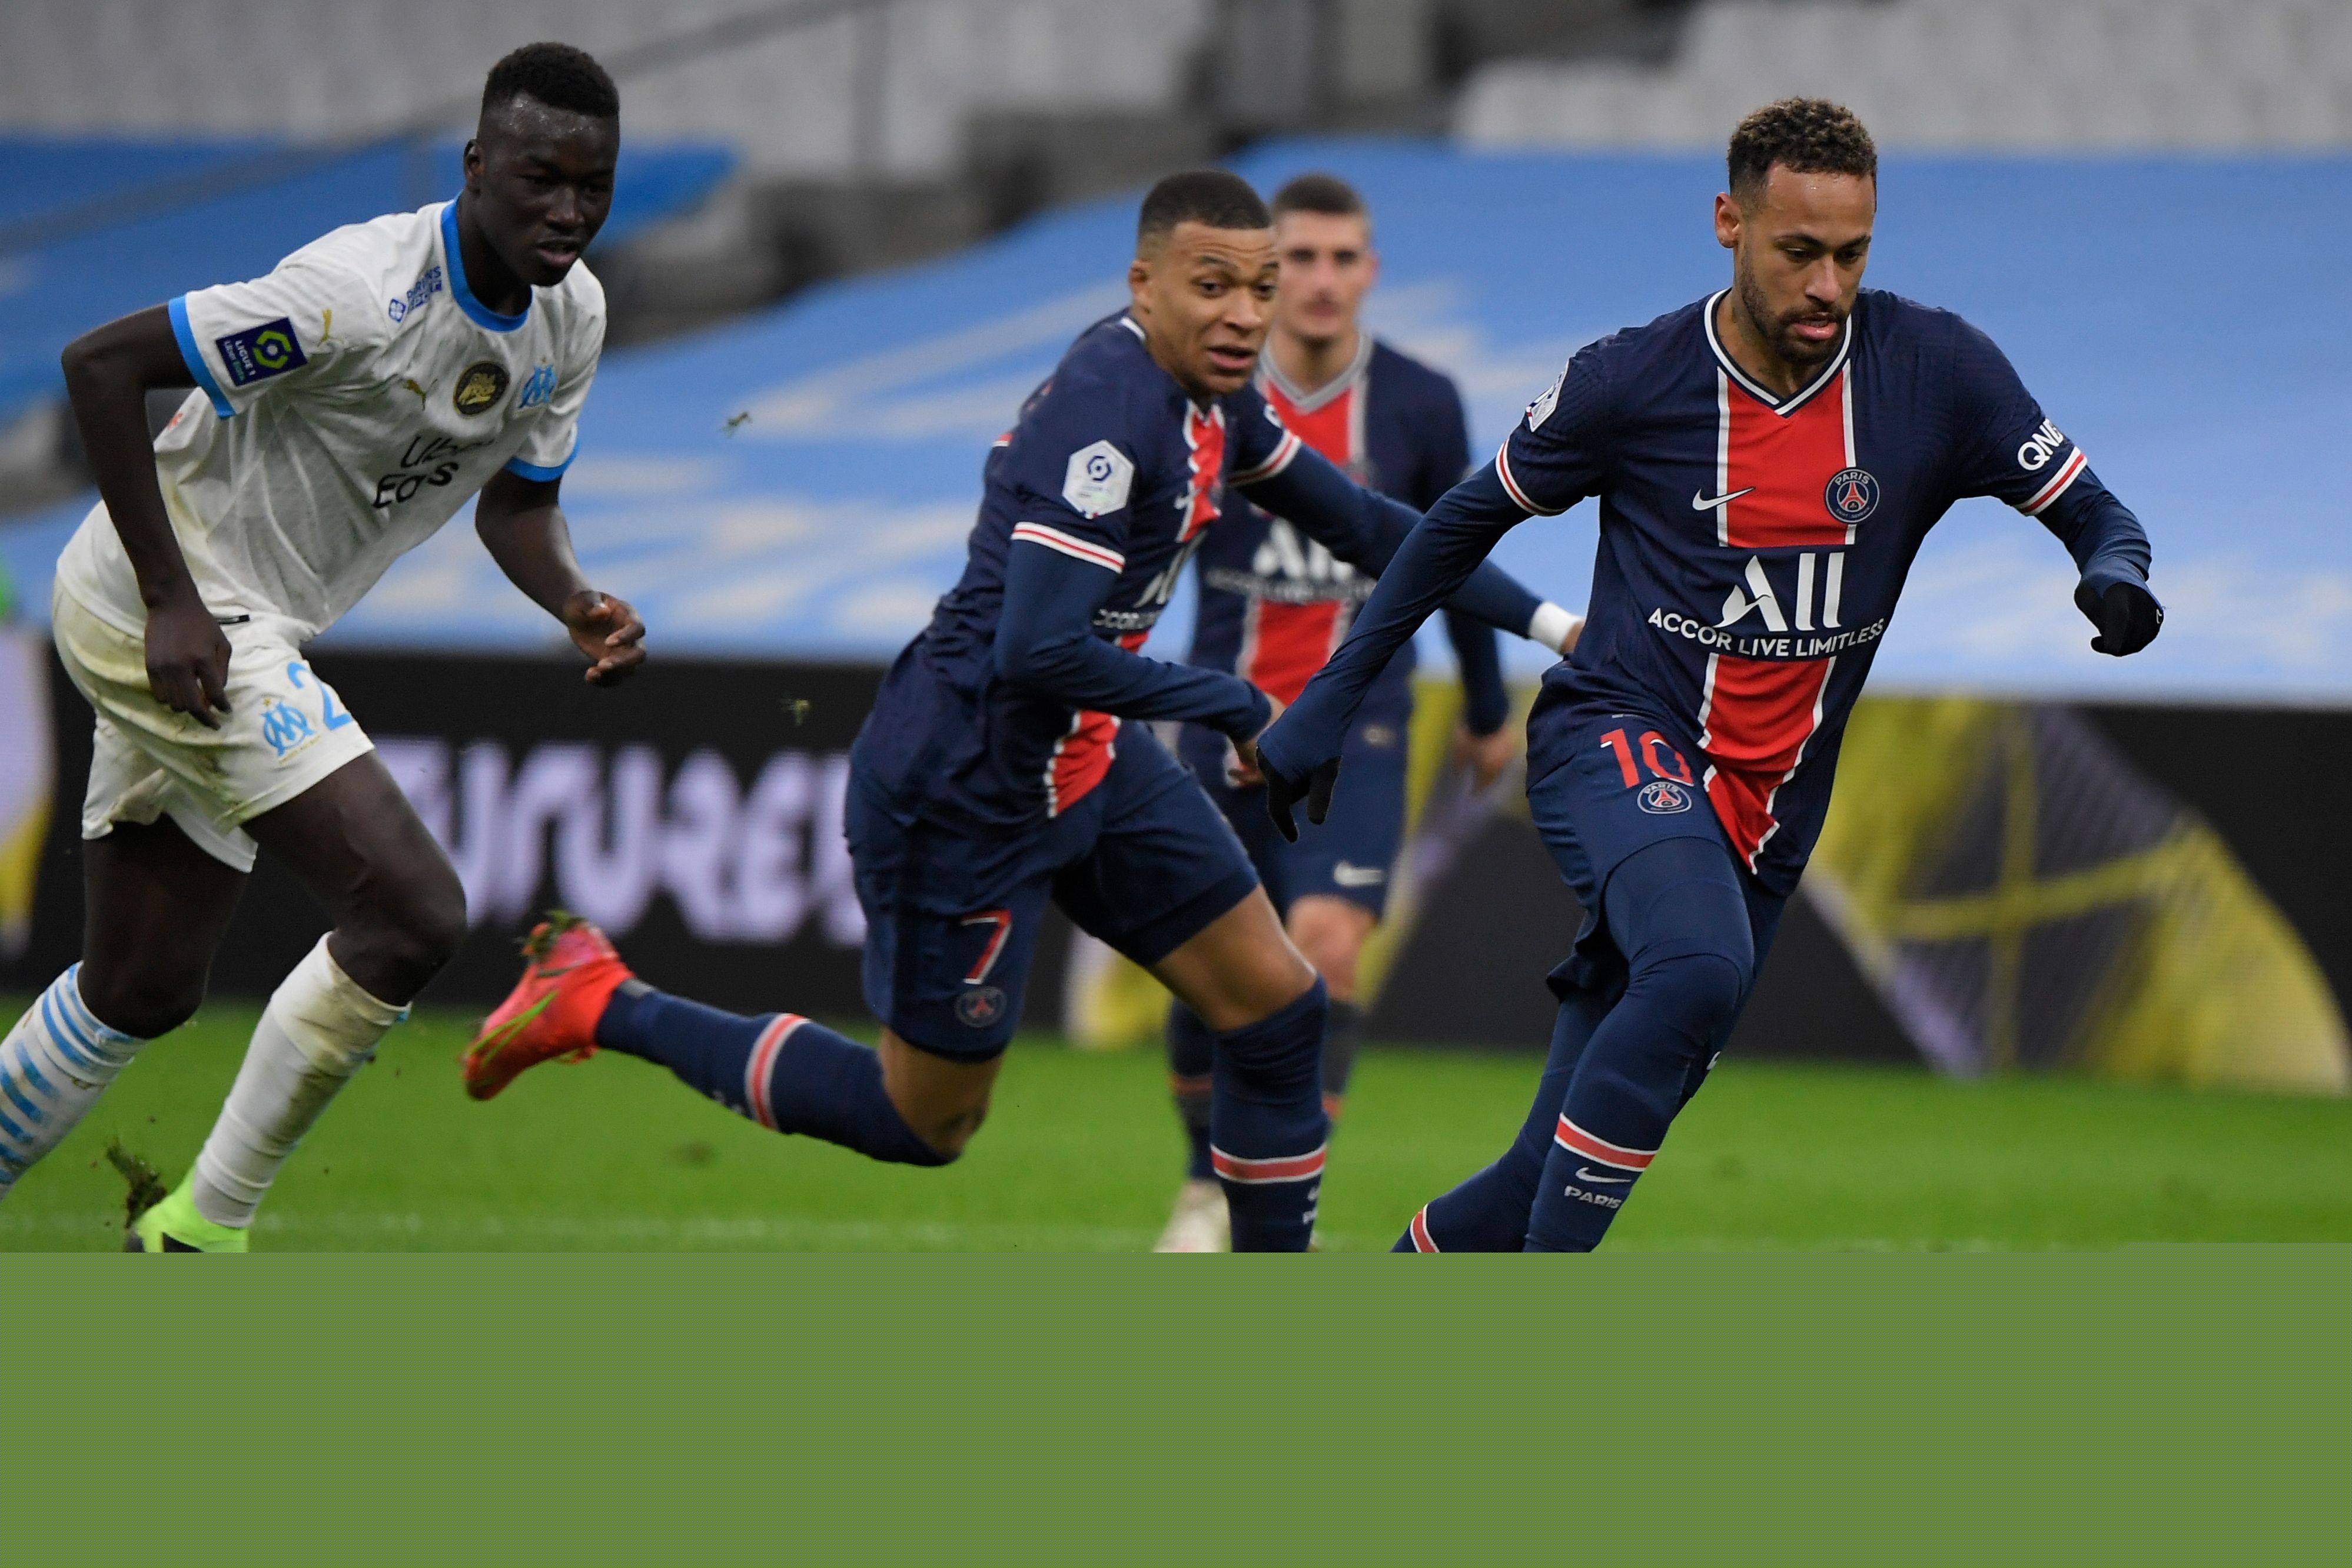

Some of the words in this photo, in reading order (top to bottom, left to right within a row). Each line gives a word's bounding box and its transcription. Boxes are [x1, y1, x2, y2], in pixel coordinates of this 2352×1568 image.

[1835, 472, 1870, 486] PARIS
[1648, 607, 1732, 651] ACCOR
[1738, 638, 1790, 656] LIVE
[1795, 618, 1884, 657] LIMITLESS
[1600, 728, 1695, 789] 10
[961, 909, 1012, 985] 7
[1564, 1185, 1622, 1209] PARIS
